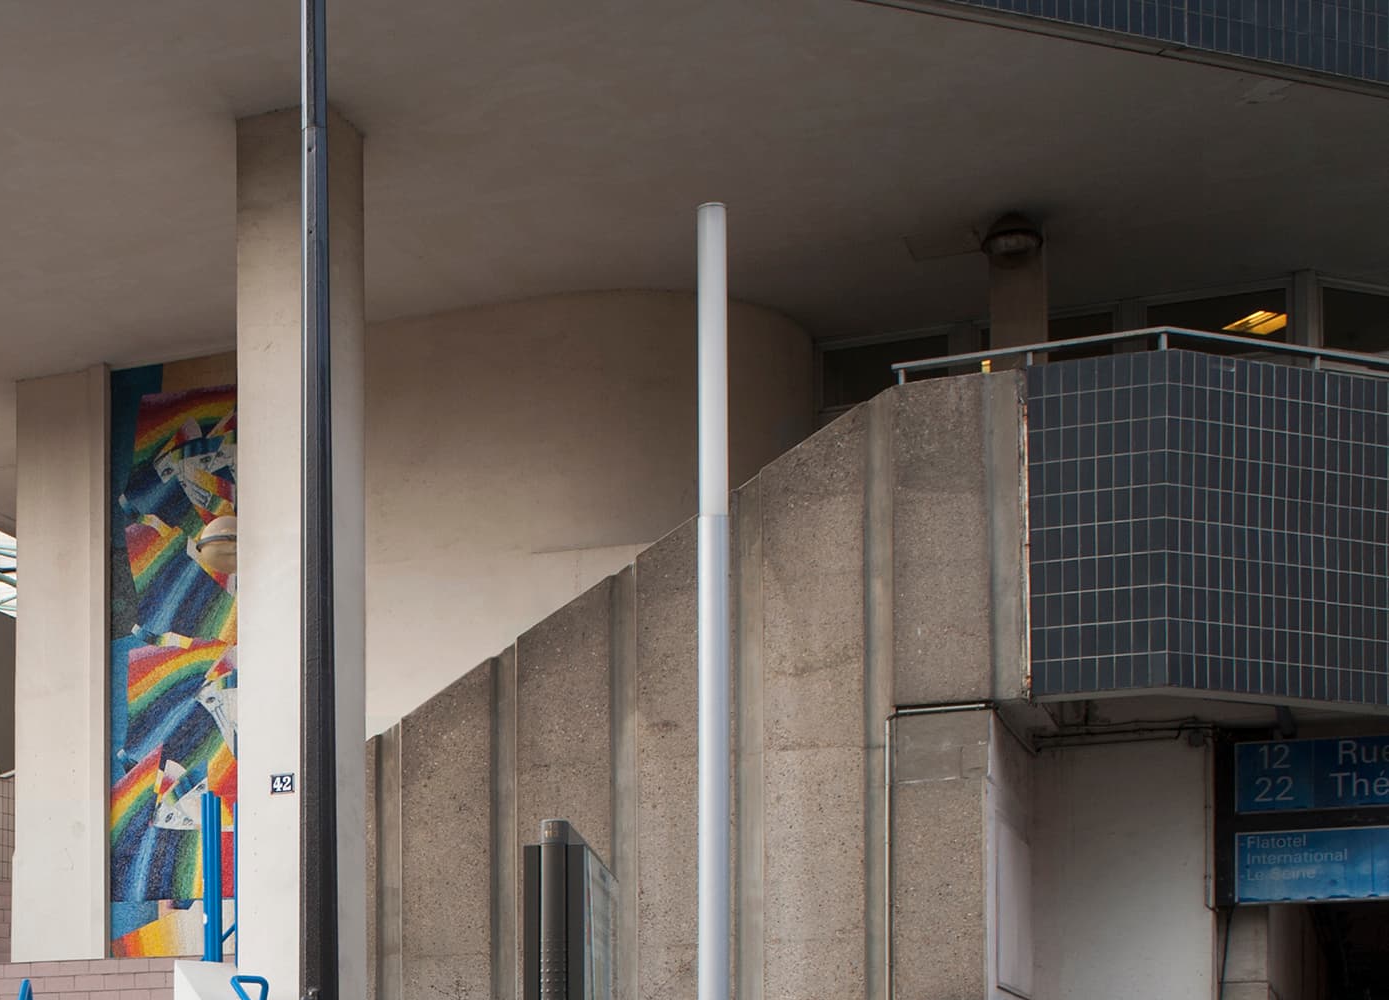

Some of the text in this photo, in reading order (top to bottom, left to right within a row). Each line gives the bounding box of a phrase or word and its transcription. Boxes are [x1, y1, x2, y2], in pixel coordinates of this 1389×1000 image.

[1258, 744, 1291, 769] 12
[273, 776, 292, 792] 42
[1253, 776, 1295, 802] 22
[1246, 834, 1307, 849] Flatotel
[1246, 849, 1348, 865] International
